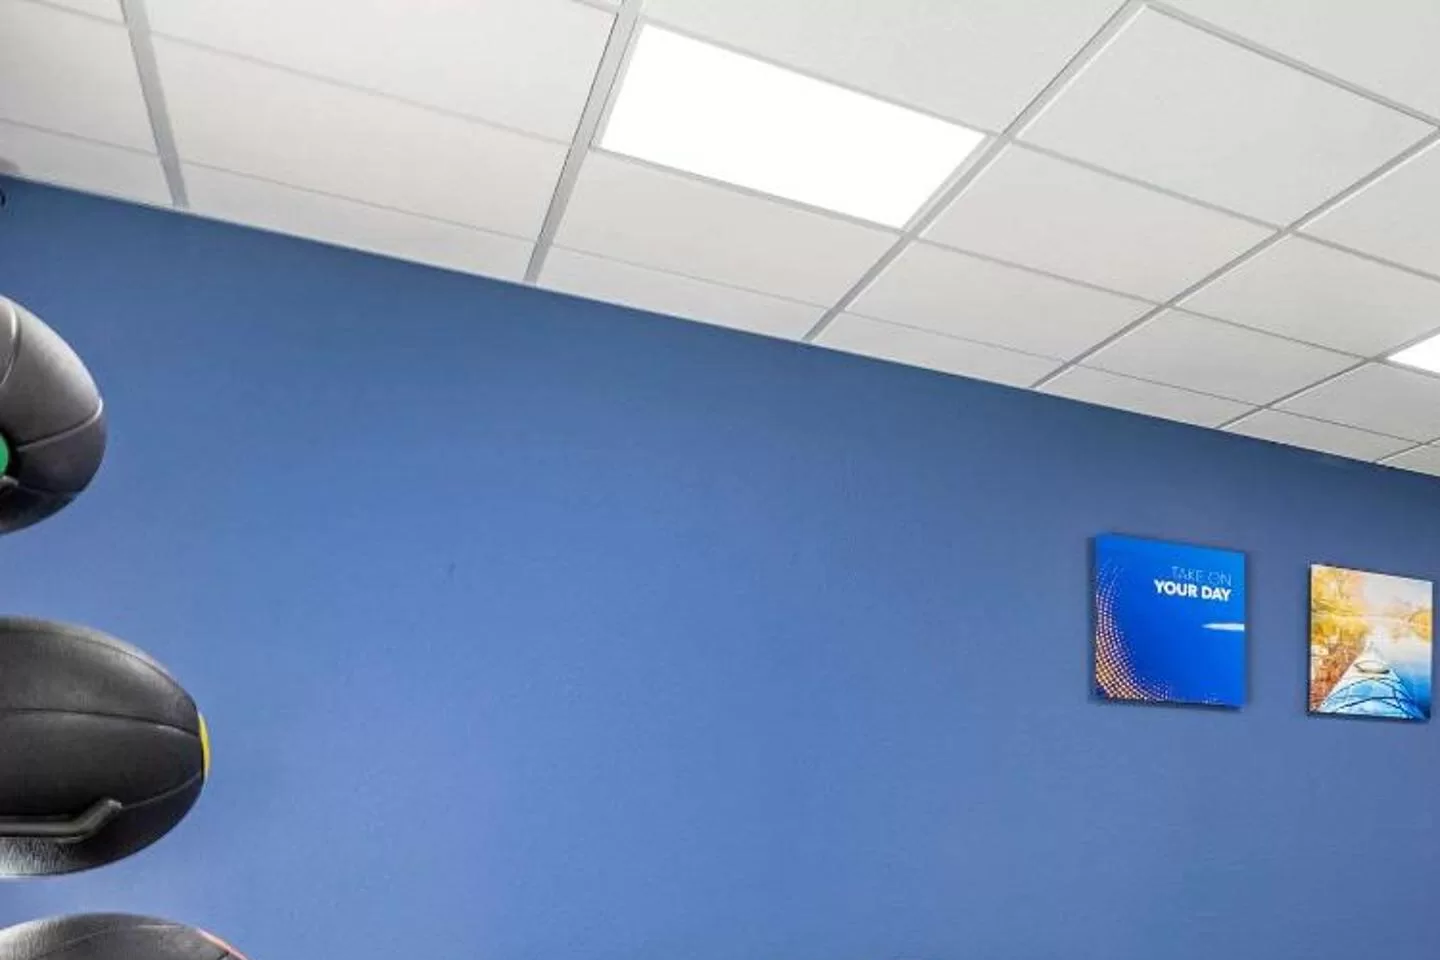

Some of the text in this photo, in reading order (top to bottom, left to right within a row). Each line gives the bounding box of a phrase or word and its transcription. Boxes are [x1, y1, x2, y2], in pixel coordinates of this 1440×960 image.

[1171, 566, 1232, 587] TAKE ON
[1153, 579, 1232, 602] YOUR DAY
